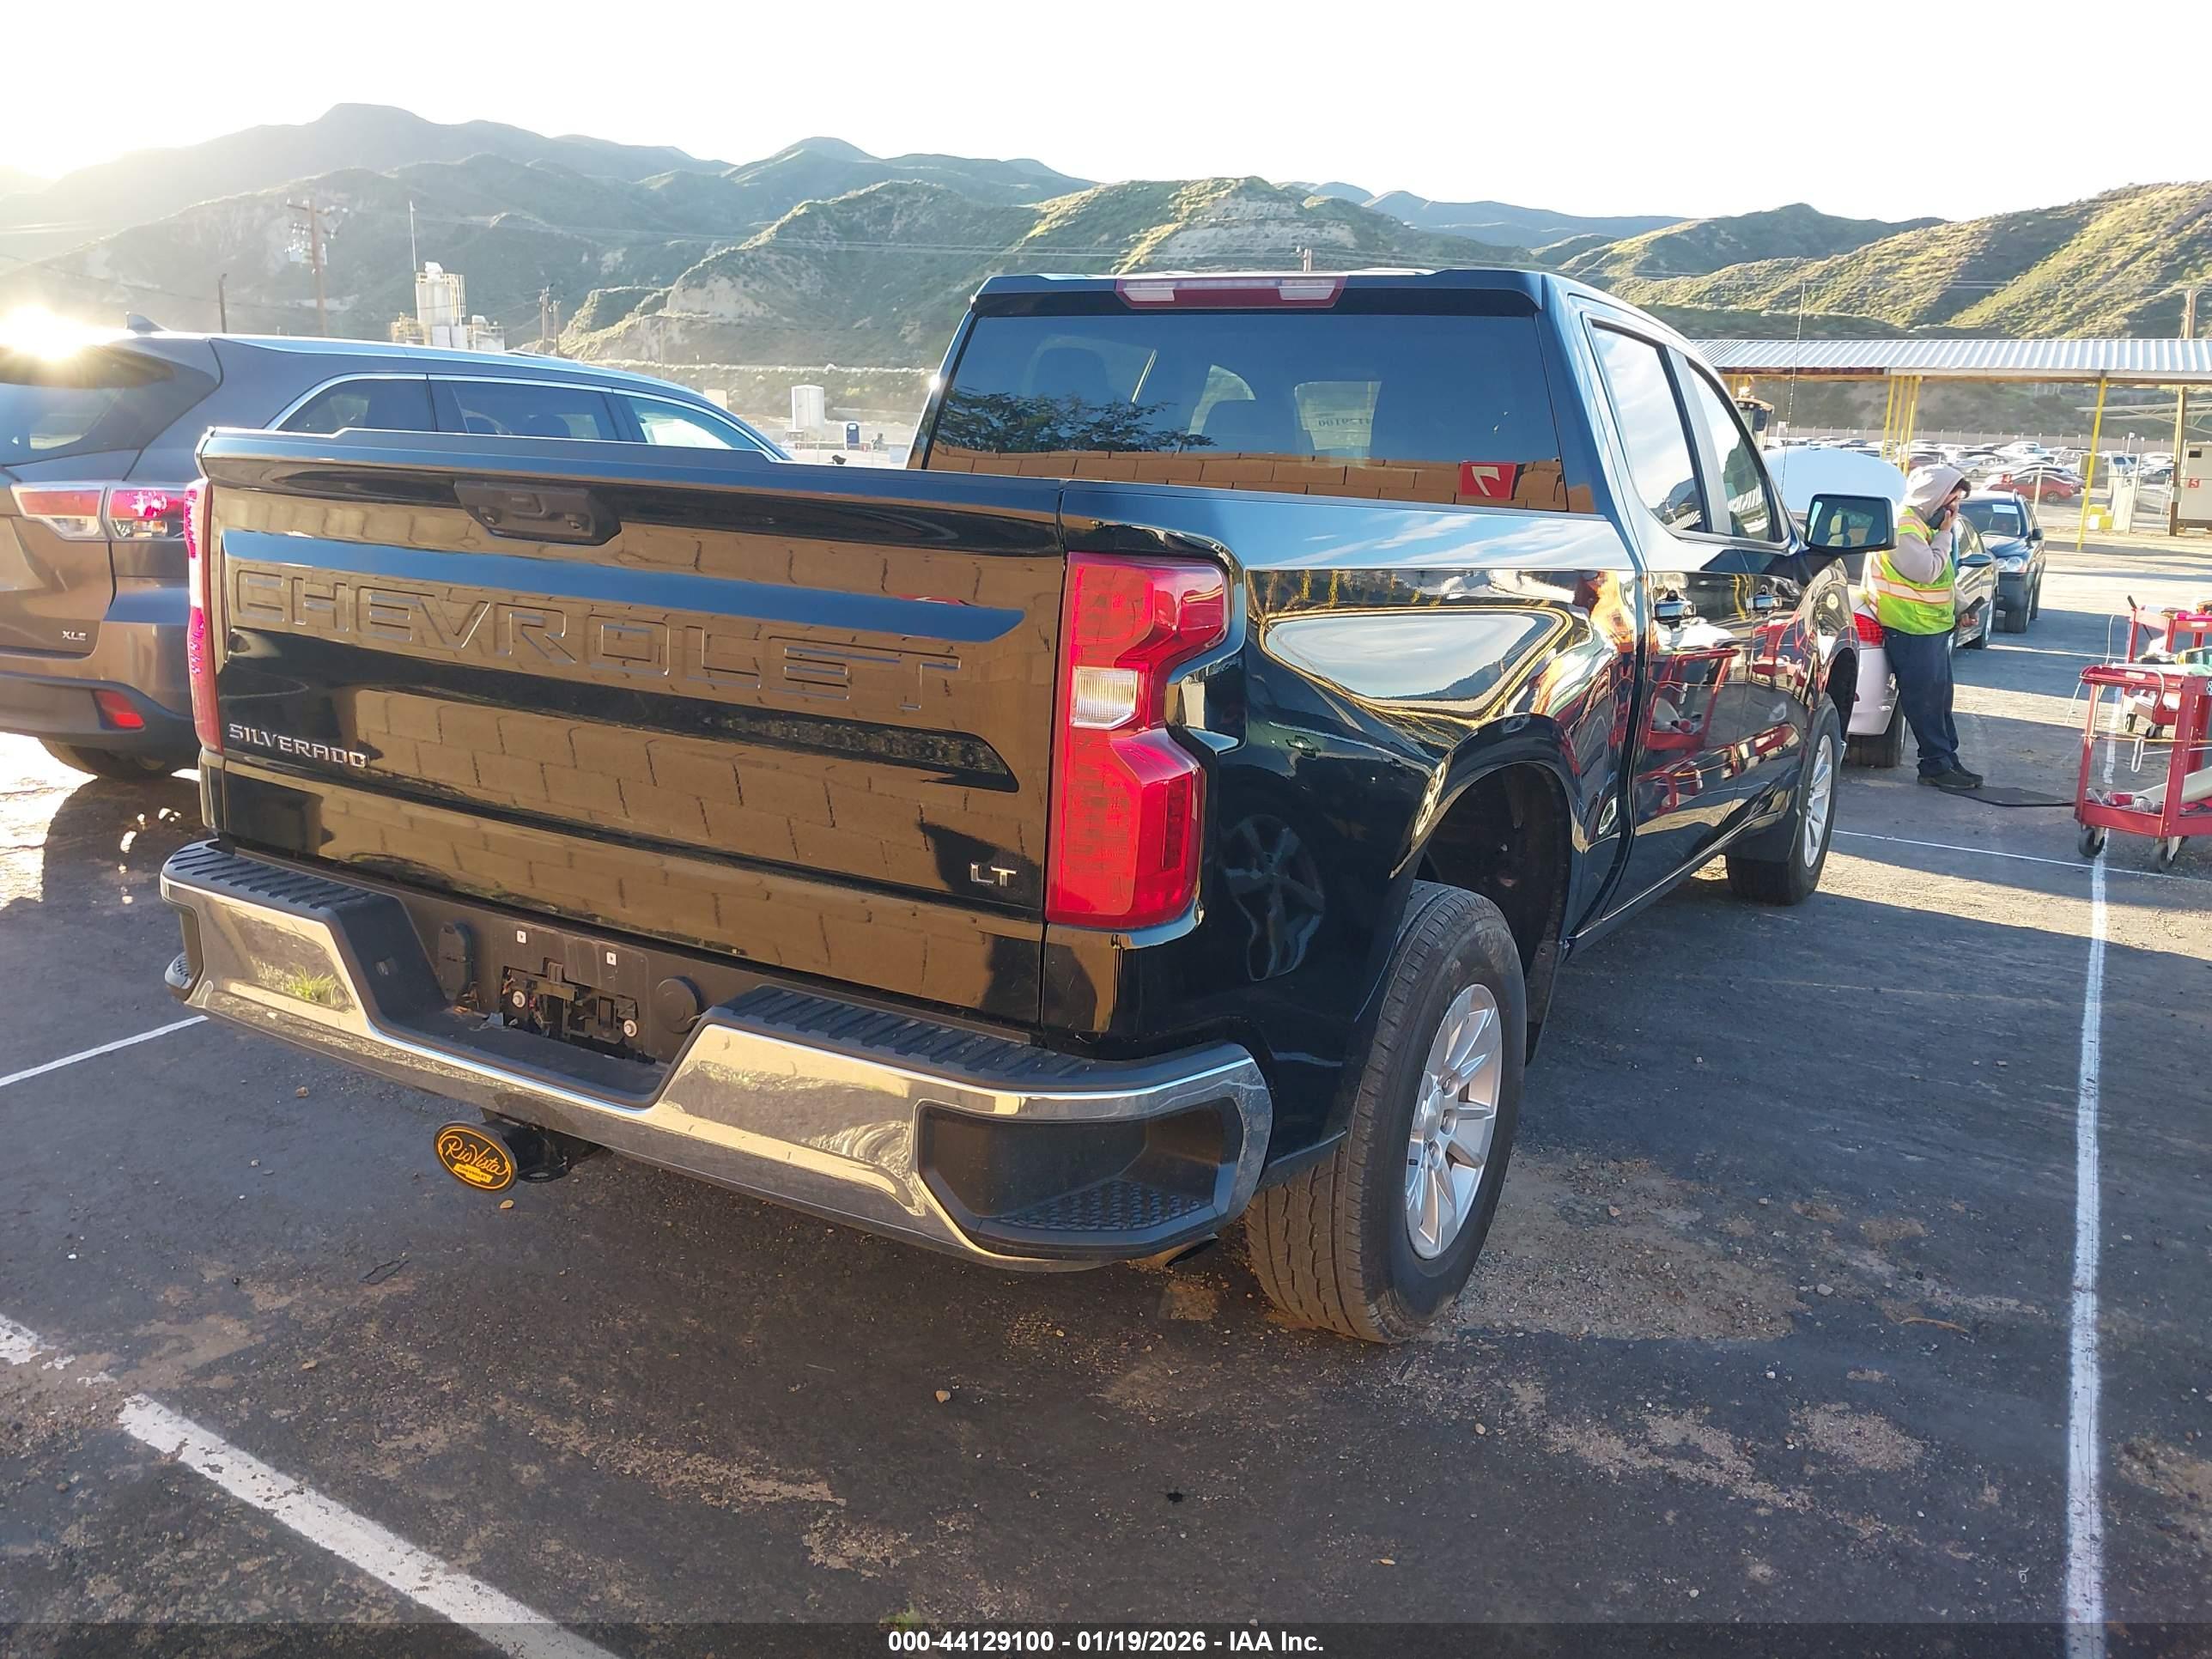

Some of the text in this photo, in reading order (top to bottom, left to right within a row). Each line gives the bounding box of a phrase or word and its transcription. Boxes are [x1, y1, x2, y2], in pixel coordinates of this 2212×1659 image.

[62, 630, 87, 641] XLE
[235, 569, 960, 710] CHEVROLET
[228, 723, 368, 768] SILVERADO
[969, 862, 1017, 886] LT
[439, 1135, 508, 1176] Rio Vista
